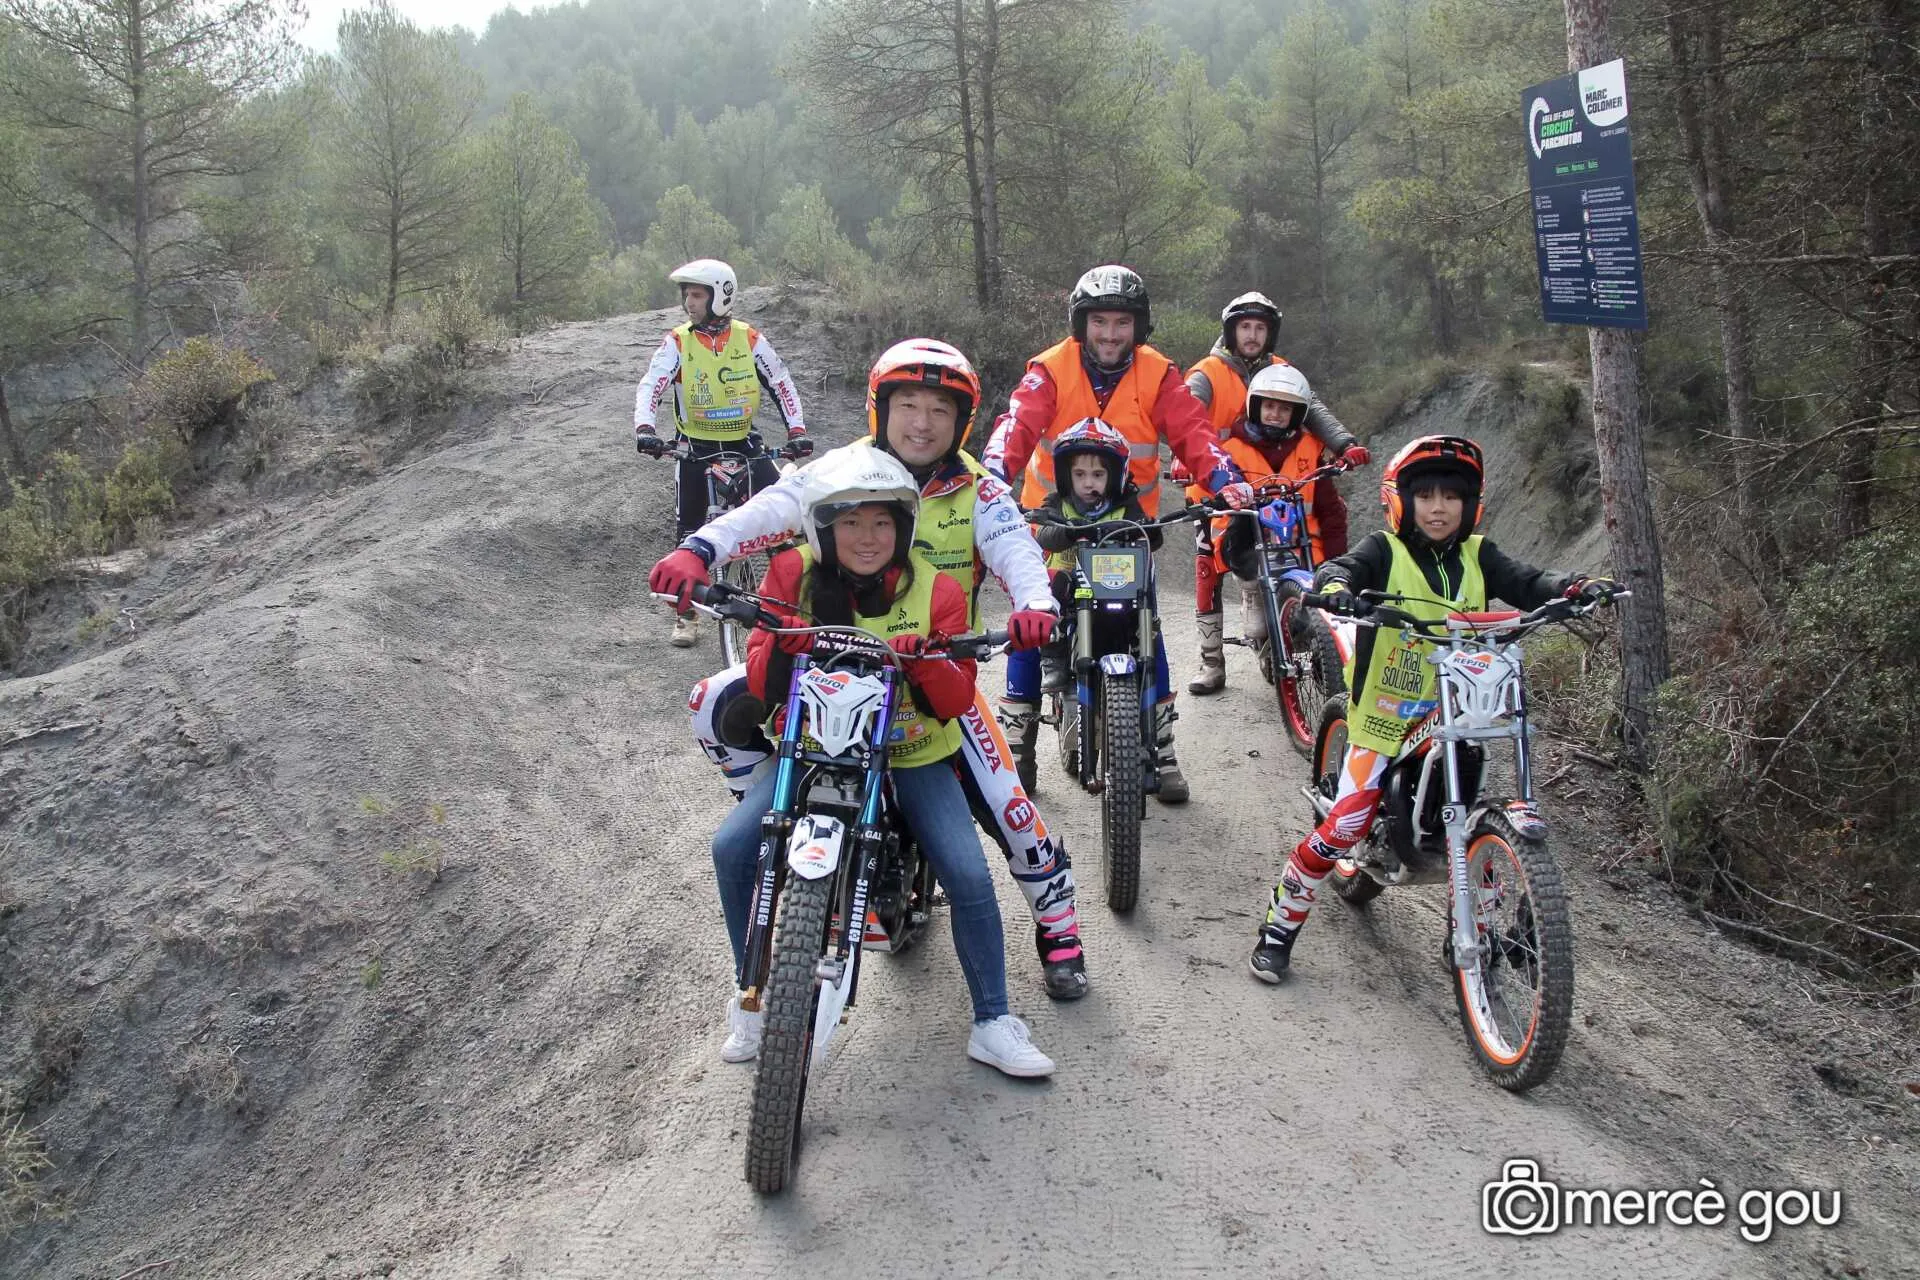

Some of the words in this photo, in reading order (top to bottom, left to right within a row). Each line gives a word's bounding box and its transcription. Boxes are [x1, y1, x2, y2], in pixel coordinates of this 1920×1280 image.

[1585, 88, 1608, 103] MARC
[1587, 96, 1623, 115] COLOMER
[1541, 119, 1574, 137] CIRCUIT
[1453, 657, 1490, 669] REPSOL
[807, 674, 846, 690] REPSOL
[1408, 712, 1440, 749] REPSO
[759, 870, 776, 919] BRAKTEC
[852, 878, 869, 929] BRAKTEC
